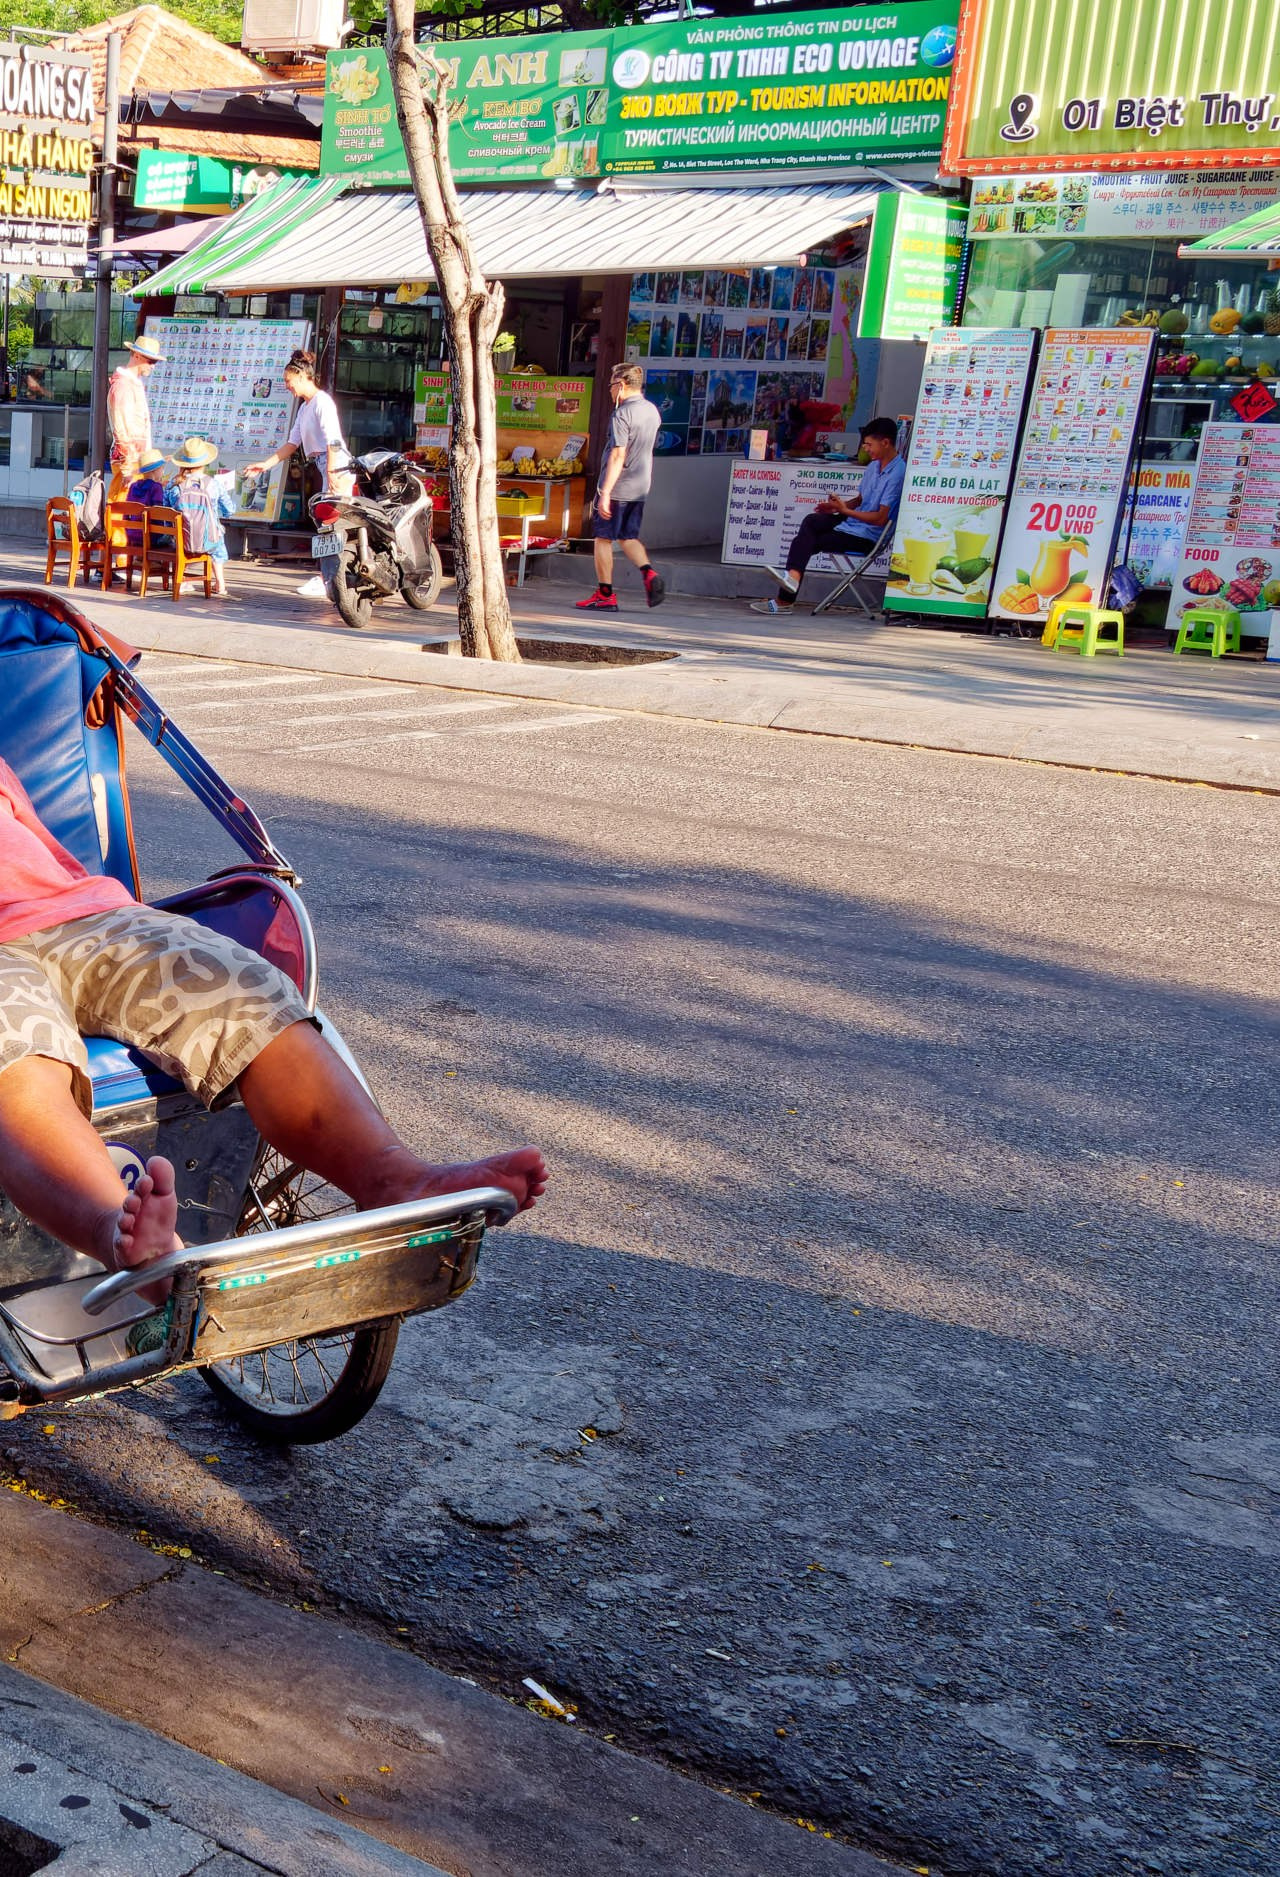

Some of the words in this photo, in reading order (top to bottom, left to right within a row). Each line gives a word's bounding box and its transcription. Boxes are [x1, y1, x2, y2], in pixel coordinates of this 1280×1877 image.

[686, 28, 714, 44] VĂN
[716, 25, 764, 42] PHÒNG
[766, 21, 814, 38] THÔNG
[817, 20, 839, 34] TIN
[842, 18, 862, 31] DU
[864, 15, 898, 33] LỊCH
[651, 48, 705, 84] CÔNG
[709, 50, 734, 80] TY
[736, 46, 790, 78] TNHH
[792, 43, 834, 74] ECO
[838, 36, 920, 71] VOYAGE
[466, 51, 549, 88] ANH
[620, 95, 652, 119] ЭКО
[654, 92, 704, 117] ВОЯЖ
[707, 89, 738, 114] ТУР
[750, 85, 826, 111] TOURISM
[827, 76, 951, 107] INFORMATION
[335, 109, 369, 125] SINH
[371, 103, 391, 123] TỐ
[483, 101, 517, 118] KEM
[1064, 98, 1100, 131] 01
[1115, 98, 1184, 136] Biệt
[339, 125, 382, 137] Smoothie
[473, 119, 506, 131] Avocado
[508, 119, 519, 129] Ice
[520, 118, 546, 129] Cream
[624, 120, 734, 148] ТУРИСТИЧЕСКИЙ
[737, 112, 887, 143] ИНФОРМАЦИОННЫЙ
[890, 114, 940, 138] ЦЕНТР
[344, 153, 374, 163] смузи
[468, 145, 522, 157] сливочный
[525, 145, 550, 157] крем
[1092, 175, 1133, 187] SMOOTHIE
[1140, 174, 1163, 185] FRUIT
[1165, 173, 1189, 185] JUICE
[1196, 171, 1247, 183] SUGARCANE
[1249, 170, 1274, 182] JUICE
[49, 186, 91, 220] NGON
[1113, 203, 1138, 215] 스무디
[1146, 202, 1162, 215] 과일
[1166, 202, 1182, 214] 주스
[1191, 202, 1224, 214] 사탕수수
[1228, 201, 1246, 213] 주스
[553, 381, 585, 392] COFFEE
[797, 470, 815, 479] ЭКО
[817, 471, 845, 480] ВОЯЖ
[911, 475, 936, 488] KEM
[940, 475, 957, 489] BƠ
[1165, 470, 1191, 488] MÍA
[789, 480, 817, 490] Русский
[818, 482, 838, 492] центр
[908, 494, 922, 503] ICE
[924, 495, 955, 505] CREAM
[957, 496, 999, 507] AVOCADO
[1026, 502, 1062, 532] 20
[1065, 503, 1098, 519] 000
[1064, 519, 1094, 534] VNĐ
[1163, 527, 1181, 541] 주스
[1184, 548, 1220, 562] FOOD
